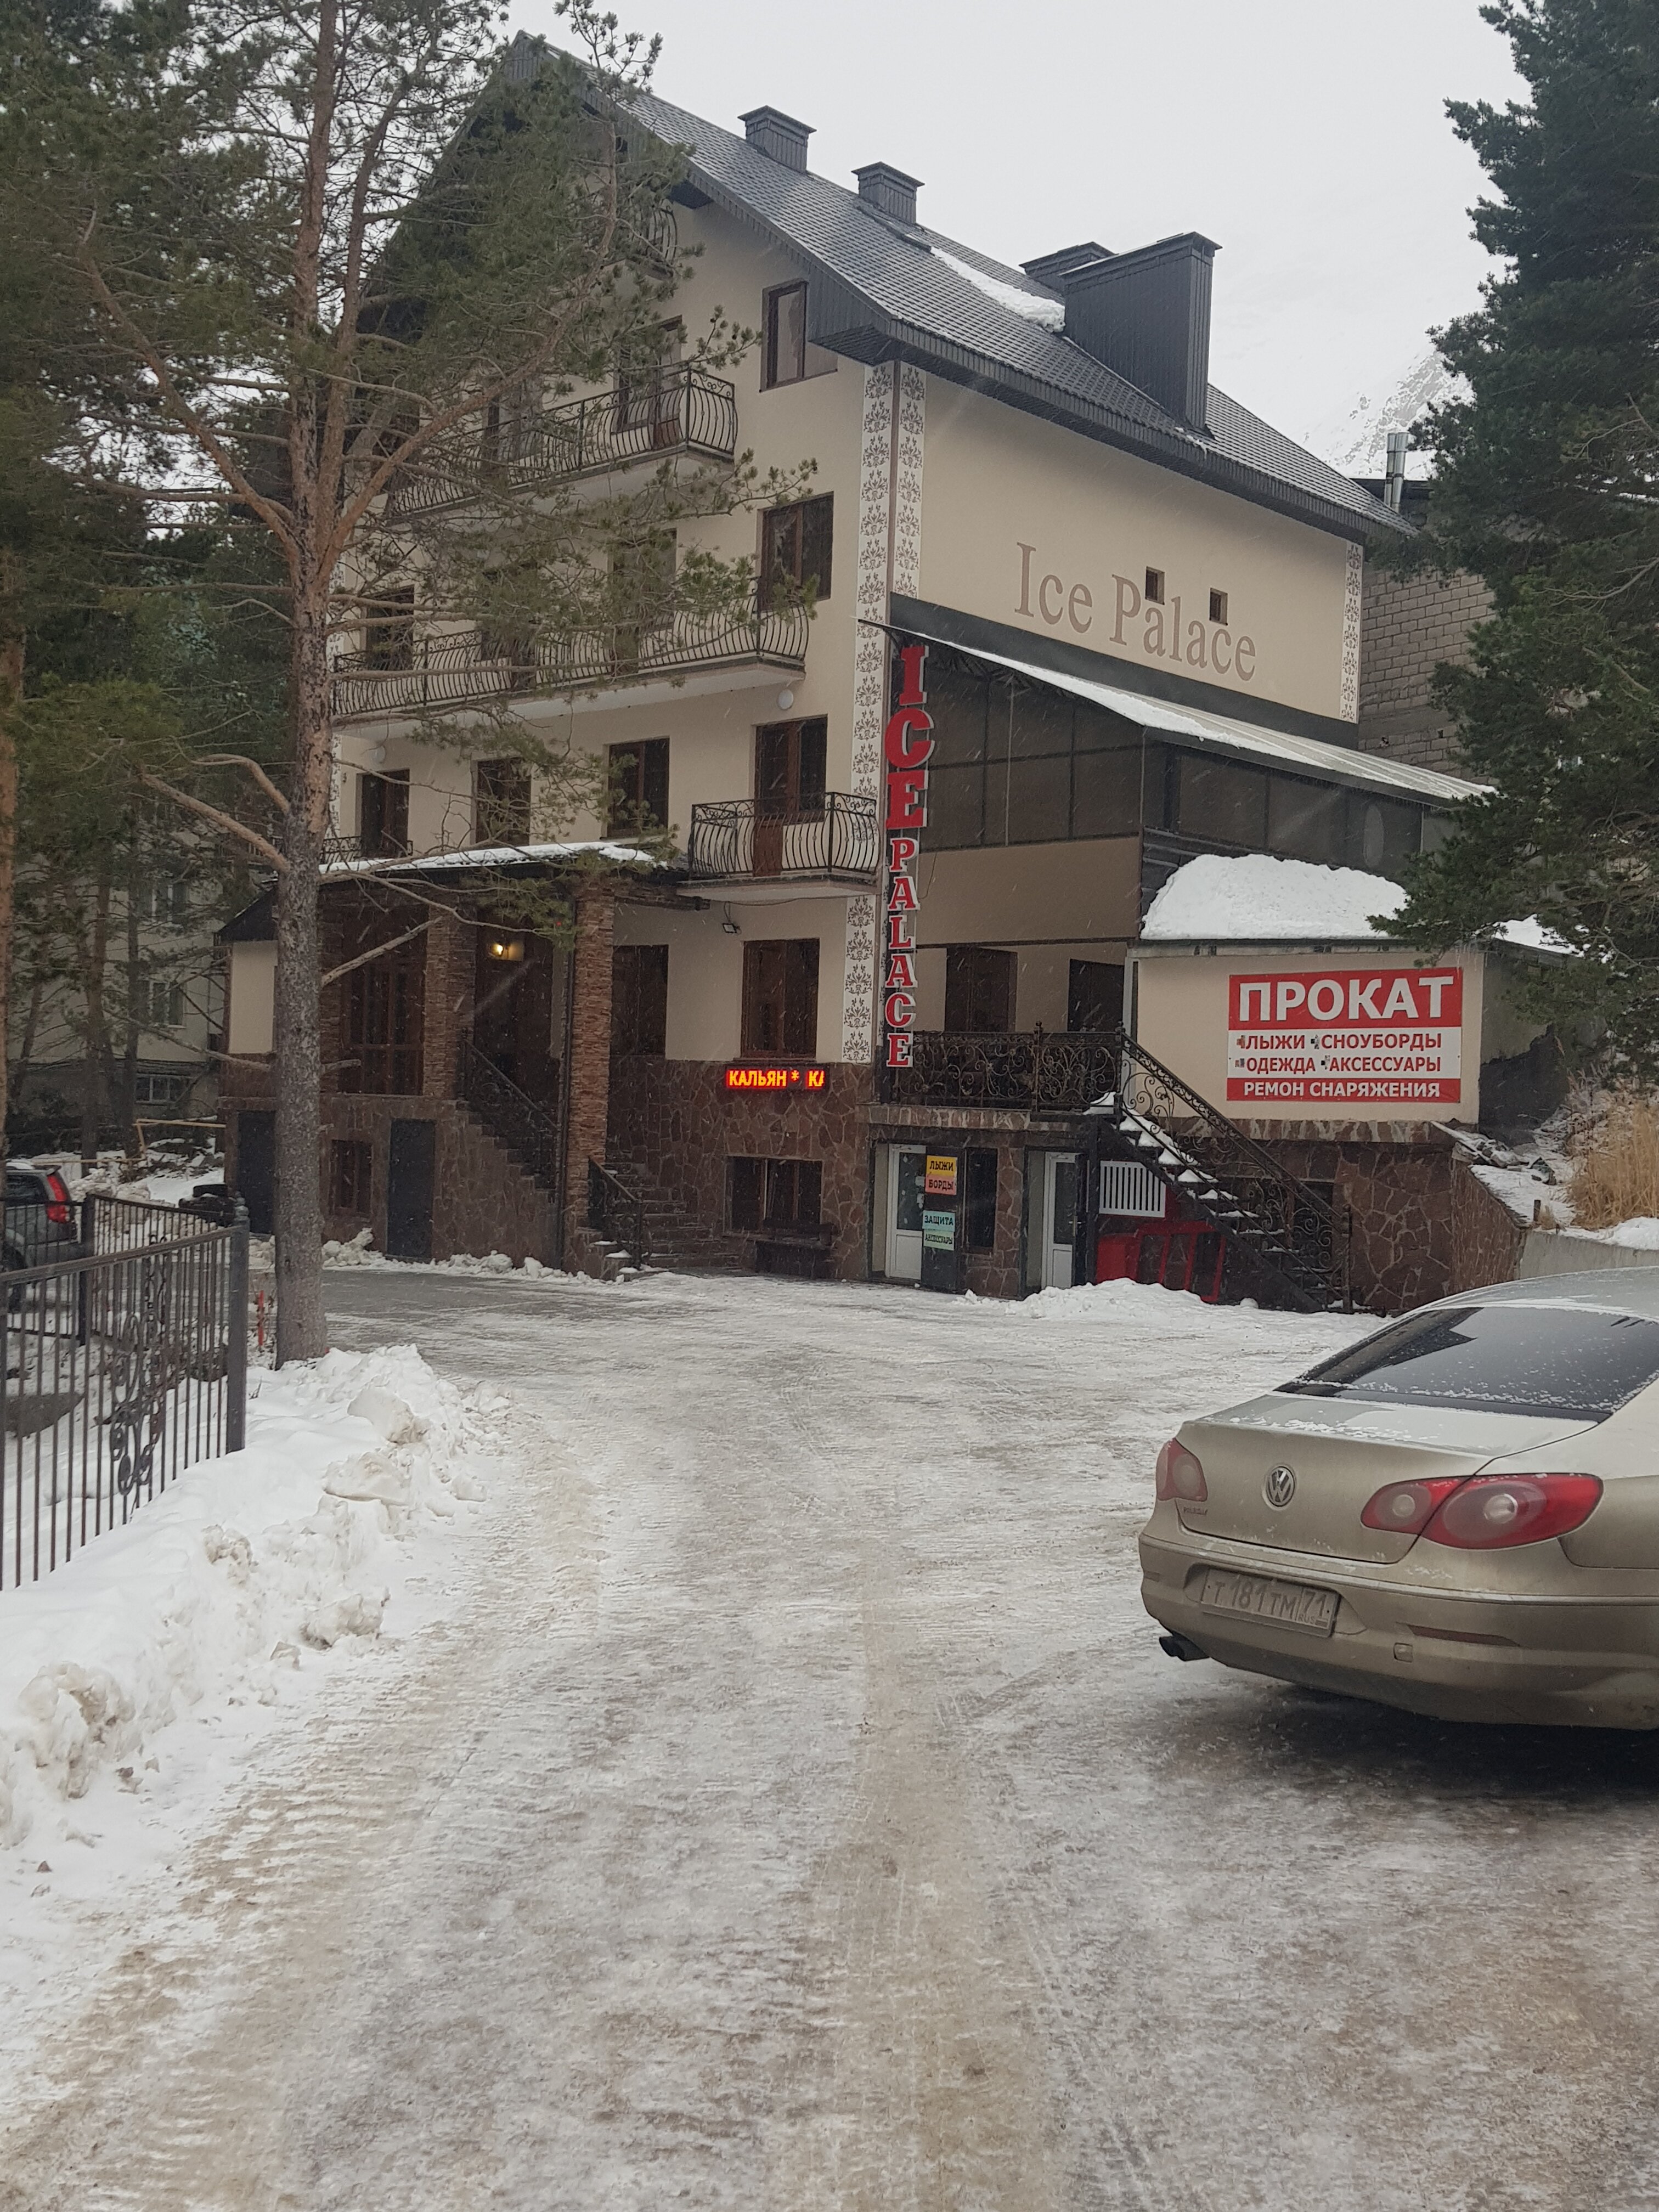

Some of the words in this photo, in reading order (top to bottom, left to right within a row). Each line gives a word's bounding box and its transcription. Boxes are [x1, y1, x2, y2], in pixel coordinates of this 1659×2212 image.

[1014, 541, 1092, 634] Ice
[1109, 574, 1256, 682] Palace
[884, 645, 935, 830] ICE
[885, 838, 920, 1068] PALACE
[1239, 976, 1454, 1022] ПРОКАТ
[1245, 1035, 1305, 1049] ЛЫЖИ
[1321, 1033, 1441, 1051] СНОУБОРДЫ
[1246, 1057, 1316, 1074] ОДЕЖДА
[1329, 1057, 1441, 1072] АКСЕССУАРЫ
[728, 1069, 787, 1087] КАЛЬЯН
[1244, 1082, 1305, 1096] РЕМОН
[1310, 1082, 1440, 1097] СНАРЯЖЕНИЯ
[929, 1160, 953, 1171] ЛЫЖИ
[928, 1179, 953, 1191] БОРДЫ
[924, 1214, 953, 1226] ЗАЩИТА
